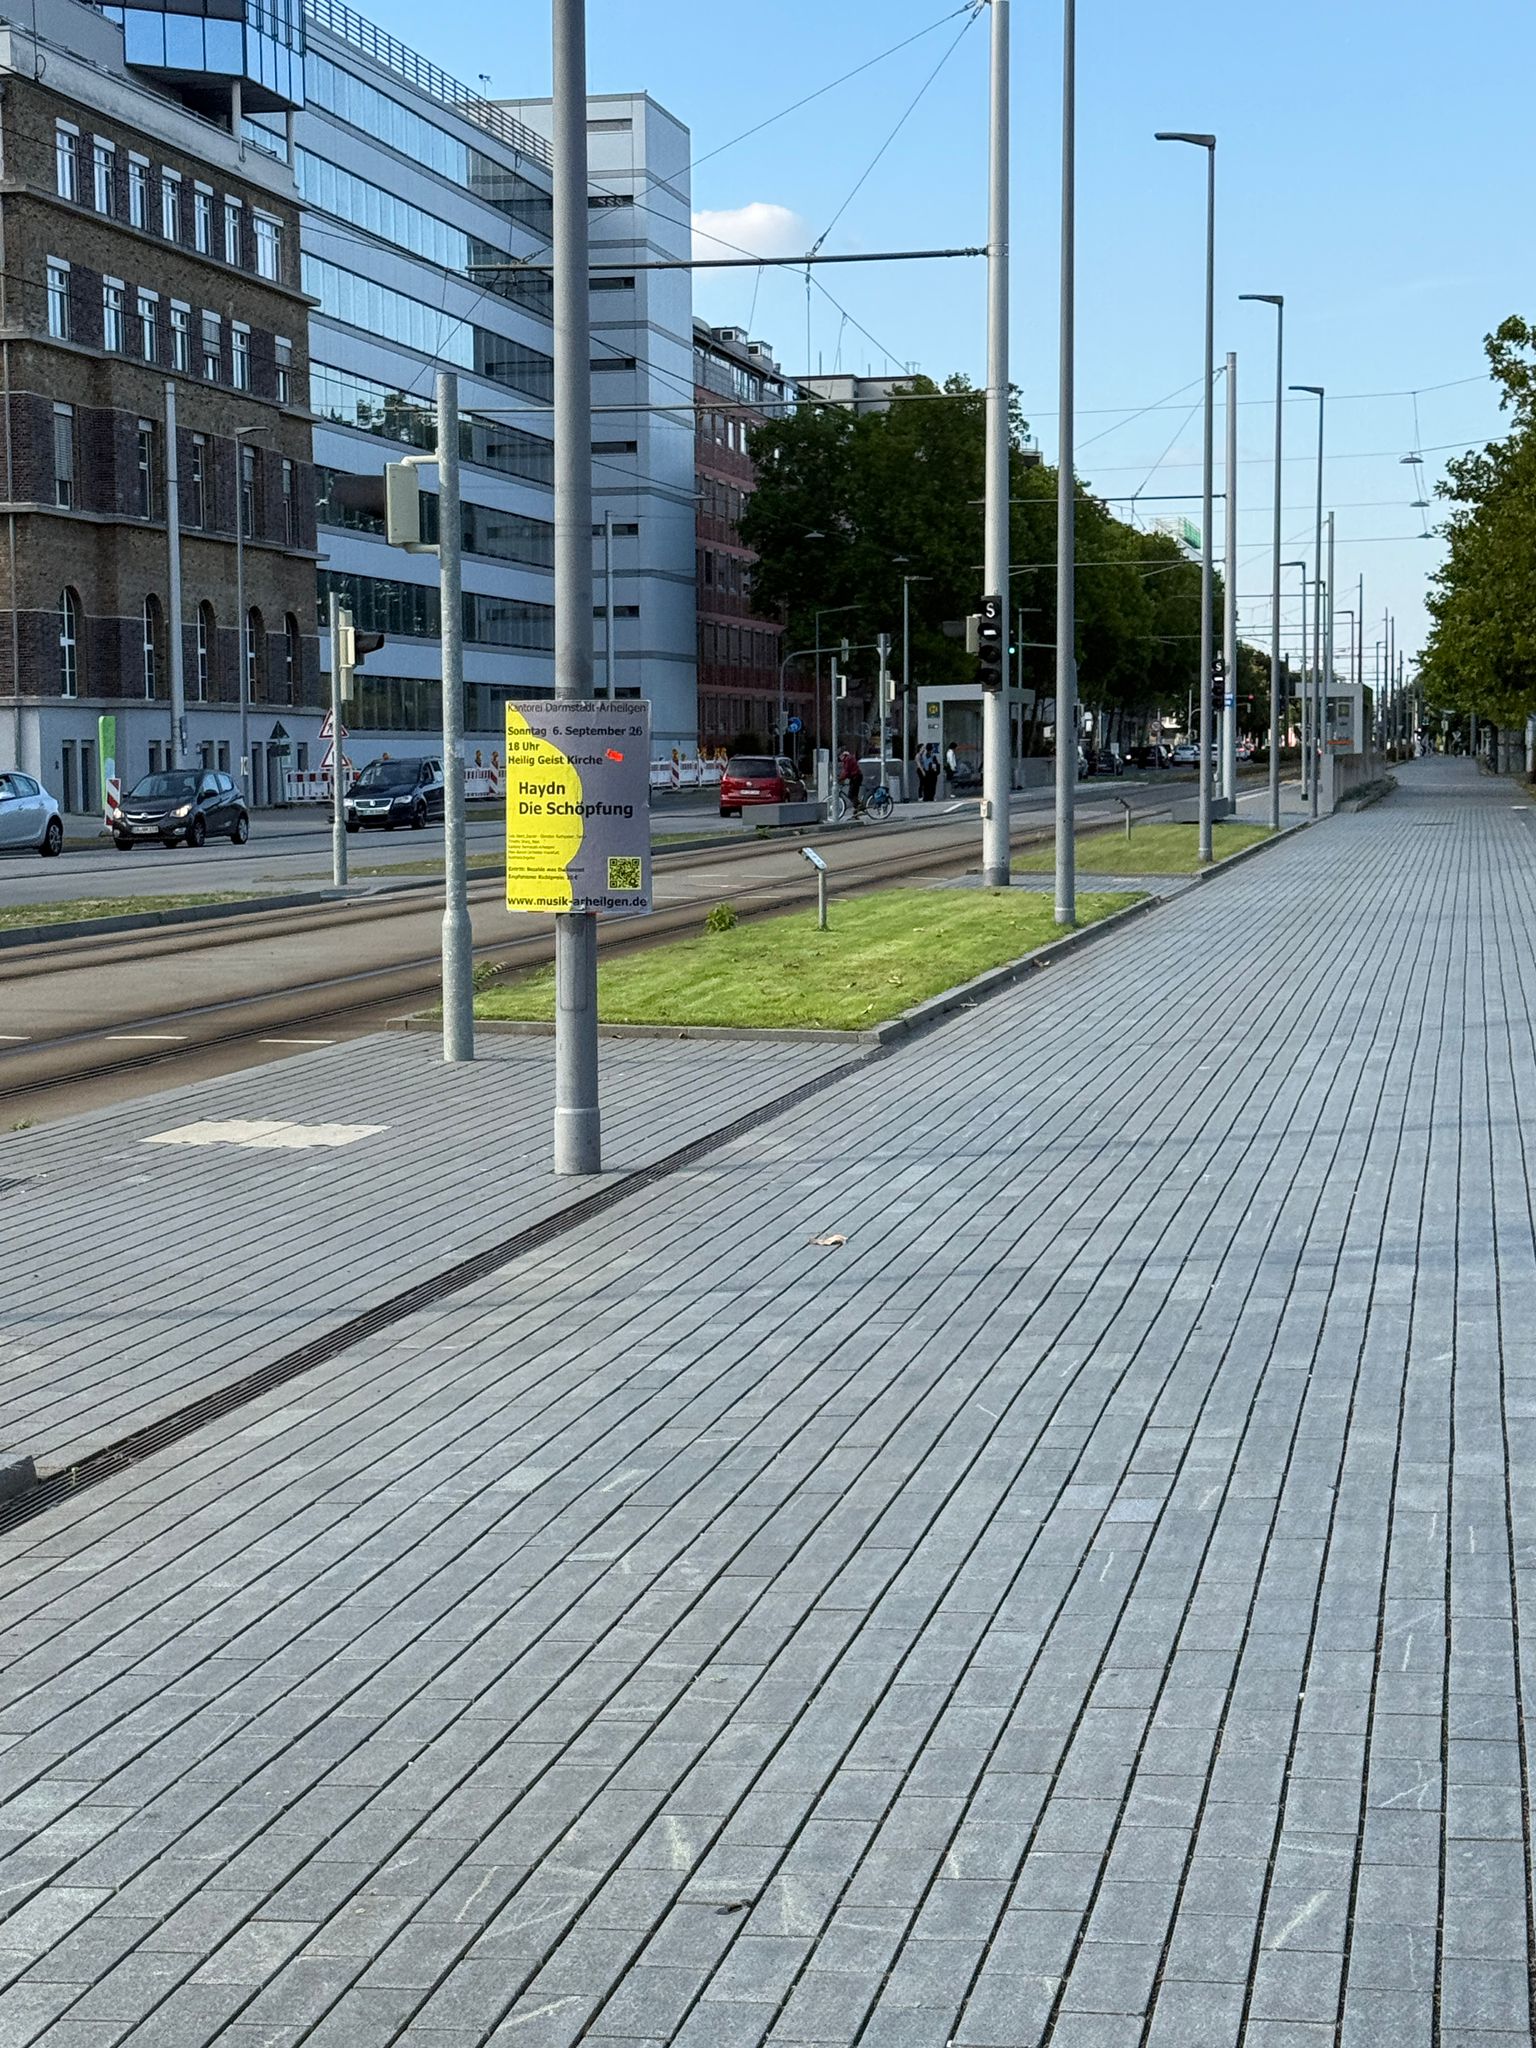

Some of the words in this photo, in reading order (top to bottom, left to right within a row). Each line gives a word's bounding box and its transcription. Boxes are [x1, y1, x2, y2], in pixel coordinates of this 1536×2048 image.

[986, 602, 995, 618] S
[1215, 662, 1222, 671] S
[545, 702, 647, 715] Darmstadt-Arheilgen
[508, 726, 547, 738] Sonntag
[552, 726, 562, 736] 6.
[565, 726, 626, 738] September
[629, 726, 643, 737] 26
[508, 742, 520, 751] 18
[522, 742, 540, 751] Uhr
[508, 756, 535, 766] Heilig
[537, 756, 564, 765] Geist
[567, 755, 603, 765] Kirche
[519, 782, 566, 798] Haydn
[519, 802, 542, 815] Die
[546, 801, 633, 818] Schöpfung
[508, 896, 647, 908] www.musik-arheilgen.de
